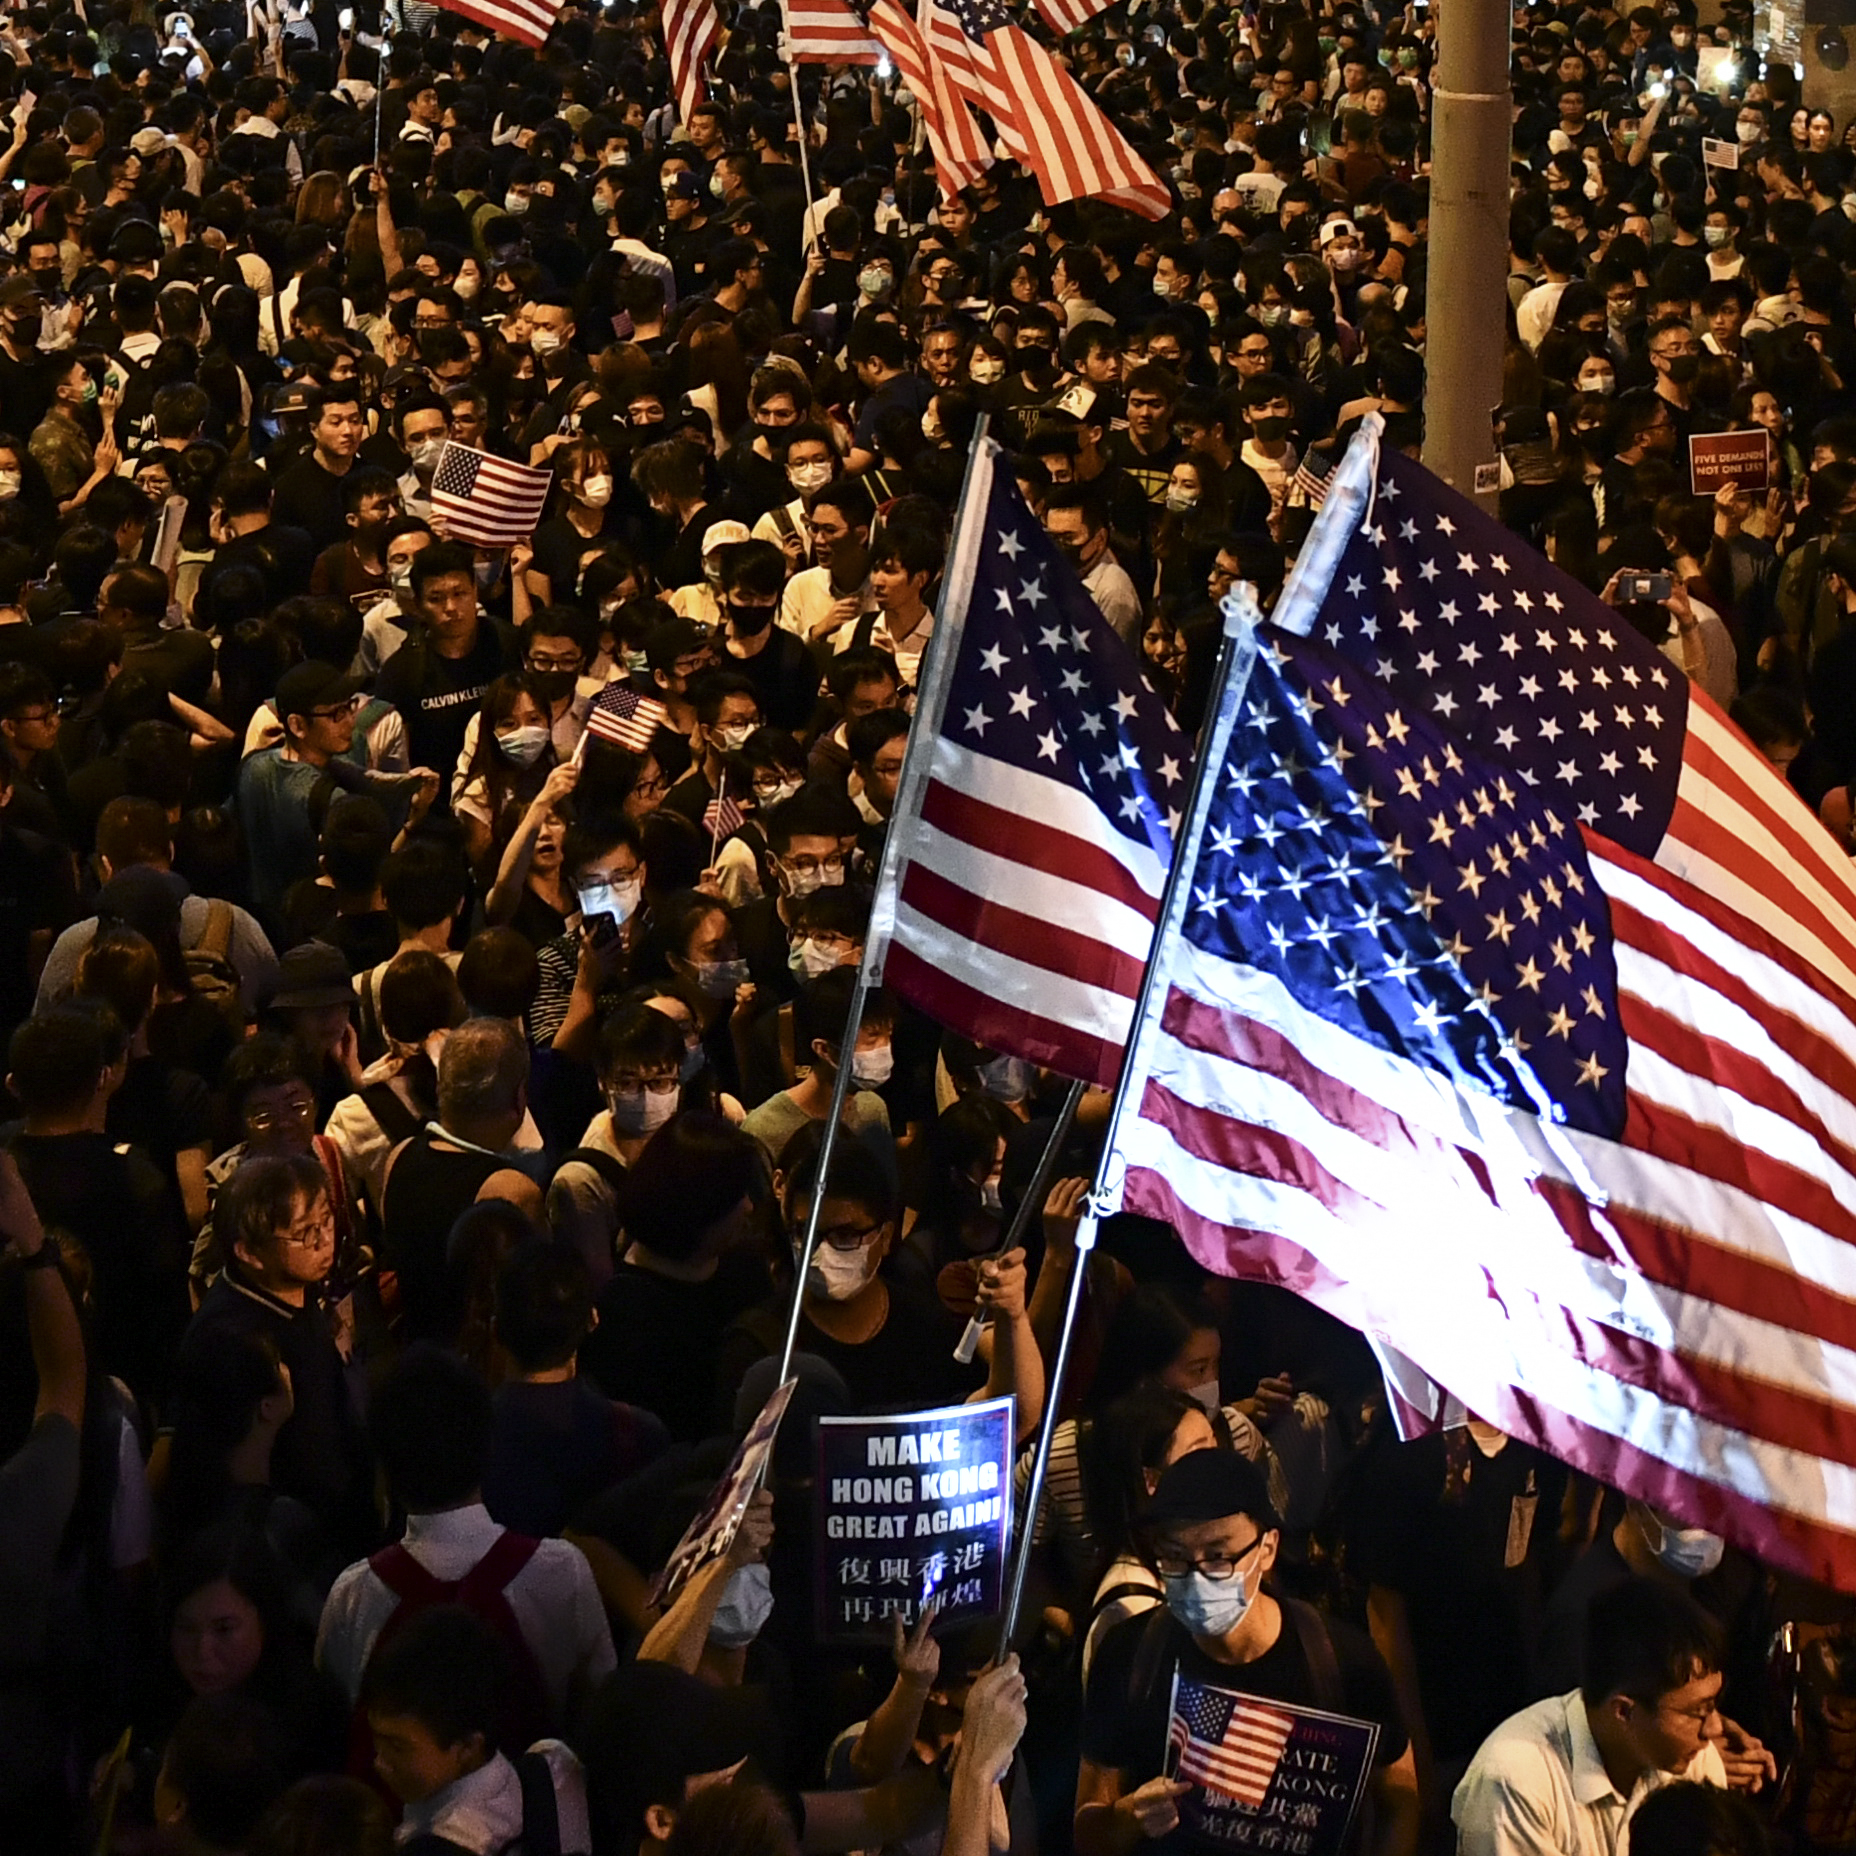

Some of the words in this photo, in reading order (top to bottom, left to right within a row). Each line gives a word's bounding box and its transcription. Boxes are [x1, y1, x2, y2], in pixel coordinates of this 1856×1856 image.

[1694, 453, 1716, 464] FIVE
[1719, 449, 1765, 464] DEMANDS
[1696, 465, 1719, 475] NOT
[1722, 464, 1743, 474] ONE
[420, 691, 458, 711] CALVIN
[459, 684, 490, 702] KLEIN
[867, 1429, 961, 1467] MAKE
[831, 1476, 914, 1505] HONG
[921, 1461, 999, 1502] KONG
[826, 1513, 910, 1540] GREAT
[913, 1495, 1002, 1538] AGAIN!
[838, 1541, 986, 1587] 復興香港
[1275, 1772, 1349, 1801] KONG
